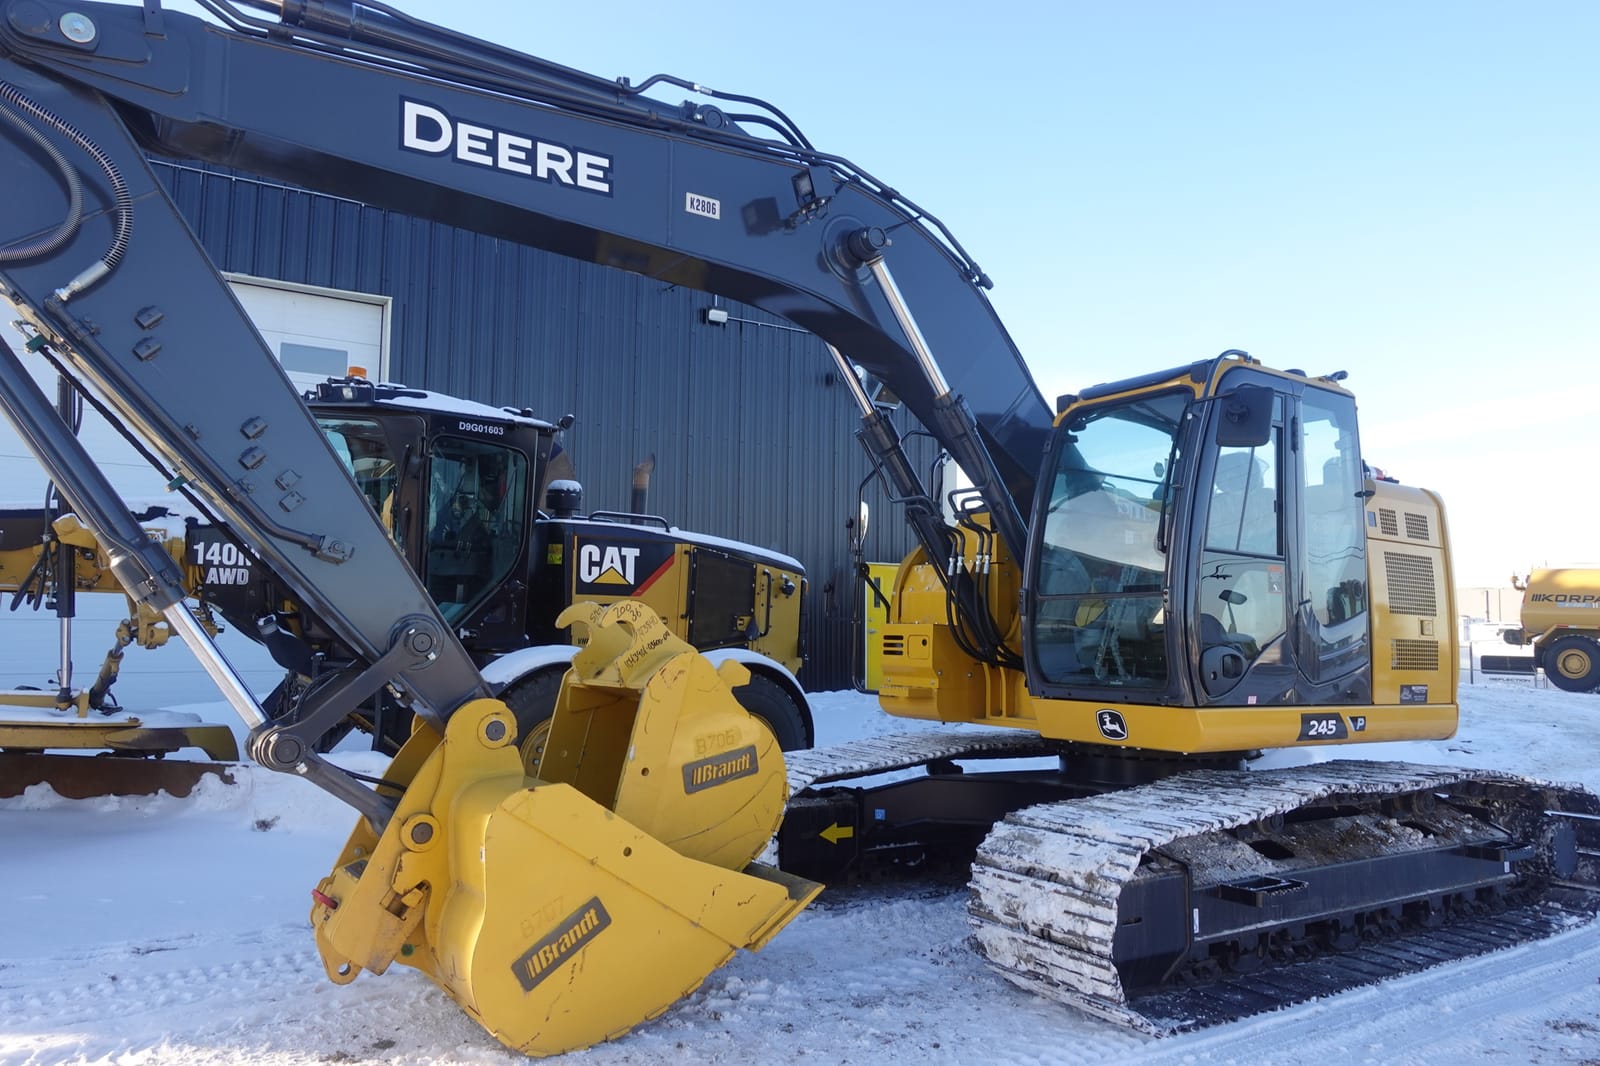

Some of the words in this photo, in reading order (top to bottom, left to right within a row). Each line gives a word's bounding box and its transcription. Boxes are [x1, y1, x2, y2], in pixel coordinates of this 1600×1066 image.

[403, 101, 610, 192] DEERE
[689, 196, 717, 216] K2806
[458, 421, 504, 436] D9G01603
[205, 567, 250, 585] AWD
[579, 544, 641, 585] CAT
[1308, 719, 1337, 736] 245
[702, 752, 751, 783] Brandt
[538, 907, 600, 970] Brandt
